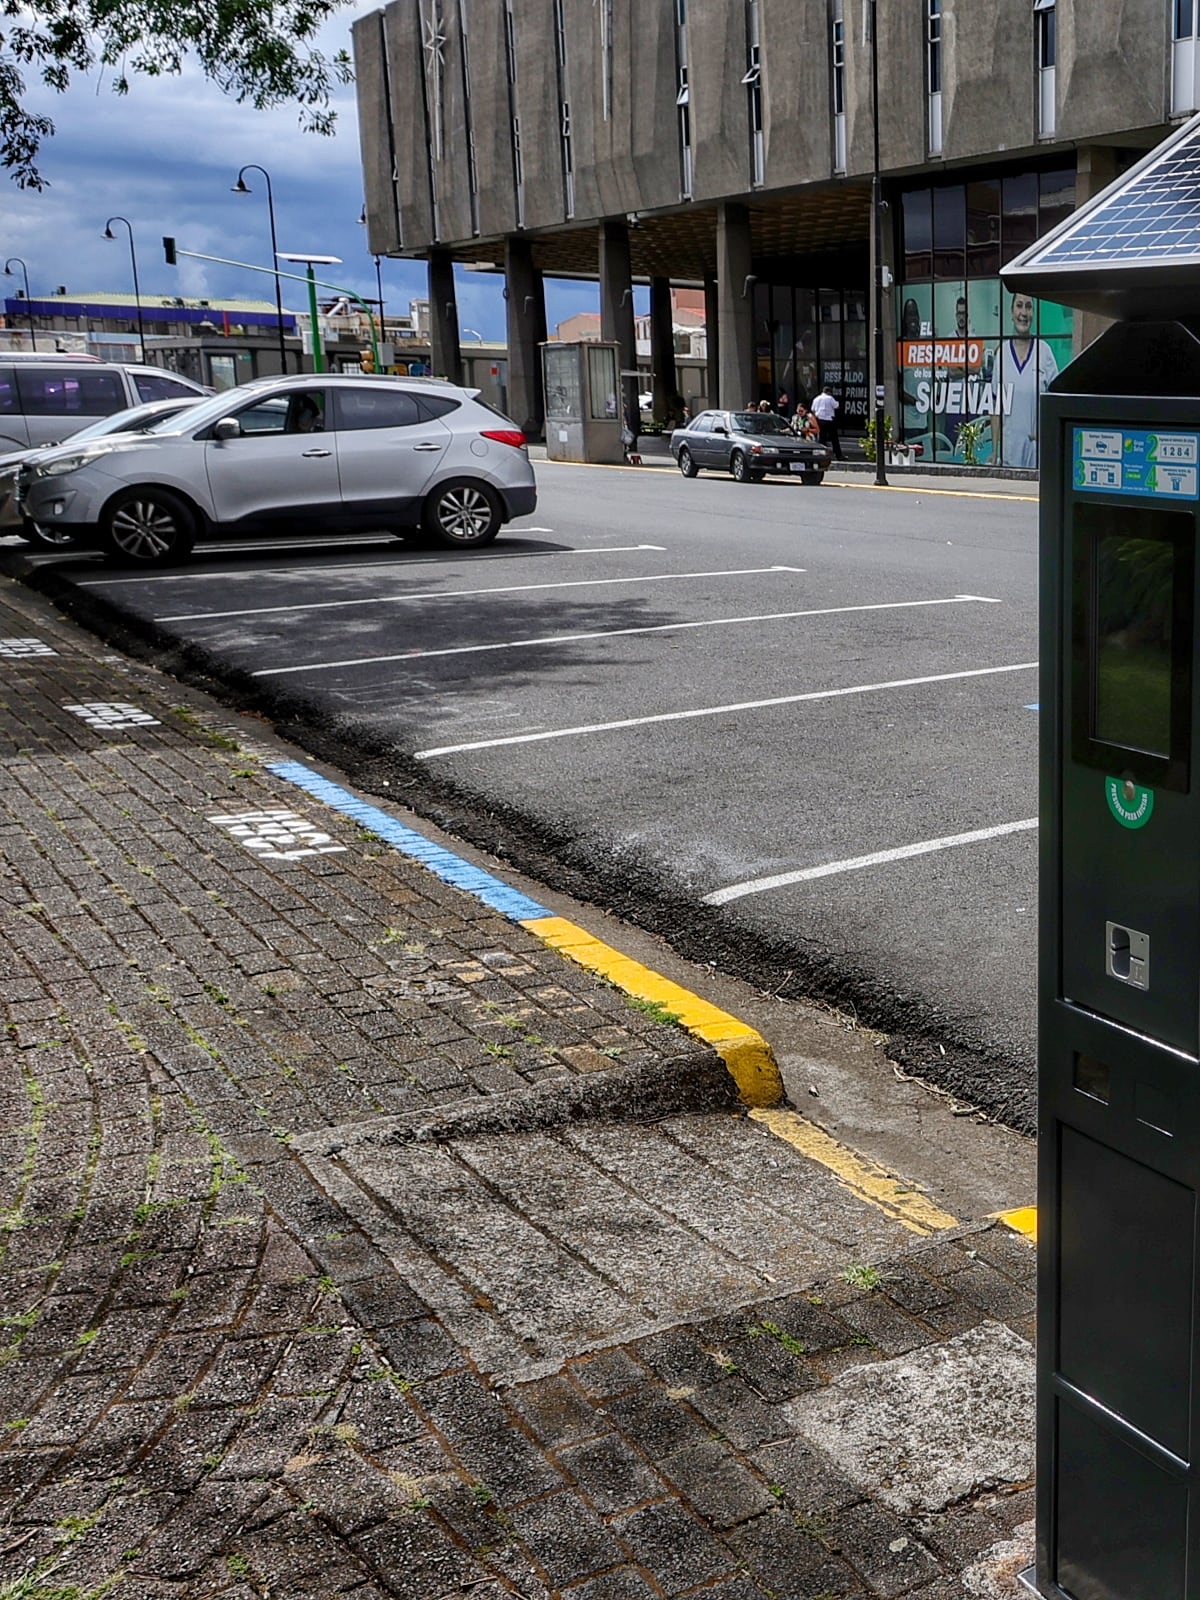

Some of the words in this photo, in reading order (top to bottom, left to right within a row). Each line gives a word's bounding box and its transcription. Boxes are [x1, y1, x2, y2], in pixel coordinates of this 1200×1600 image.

[920, 321, 933, 336] EL
[908, 343, 979, 364] RESPALDO
[914, 367, 922, 378] de
[922, 368, 932, 378] los
[935, 369, 948, 380] que
[915, 374, 1015, 416] SUEÑAN
[1146, 434, 1158, 462] 2
[1076, 460, 1086, 486] 3
[1145, 465, 1158, 491] 4
